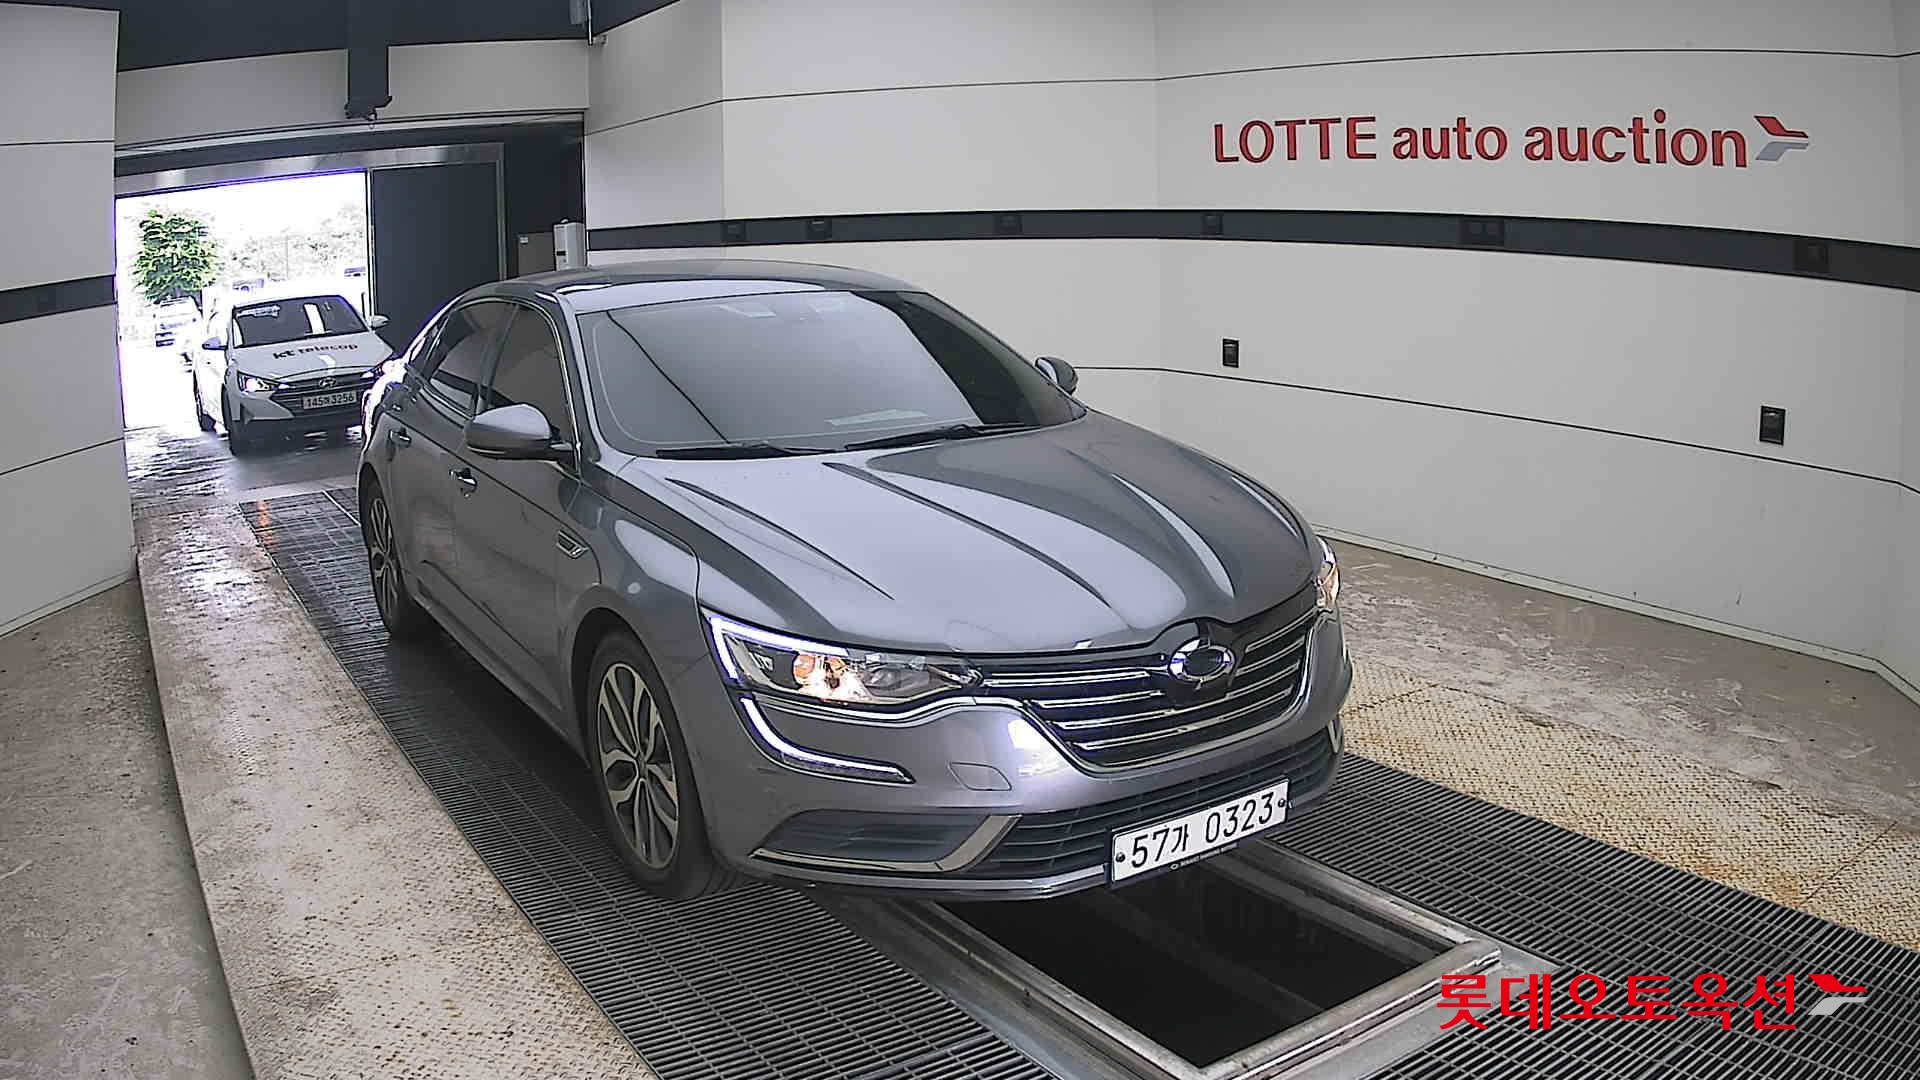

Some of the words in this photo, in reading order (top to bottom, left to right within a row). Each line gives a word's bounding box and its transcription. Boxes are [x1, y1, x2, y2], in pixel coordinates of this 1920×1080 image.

[1213, 116, 1378, 163] LOTTE
[1392, 117, 1508, 161] auto
[1524, 107, 1748, 168] auction
[1131, 823, 1189, 868] 57가
[1205, 791, 1275, 844] 0323
